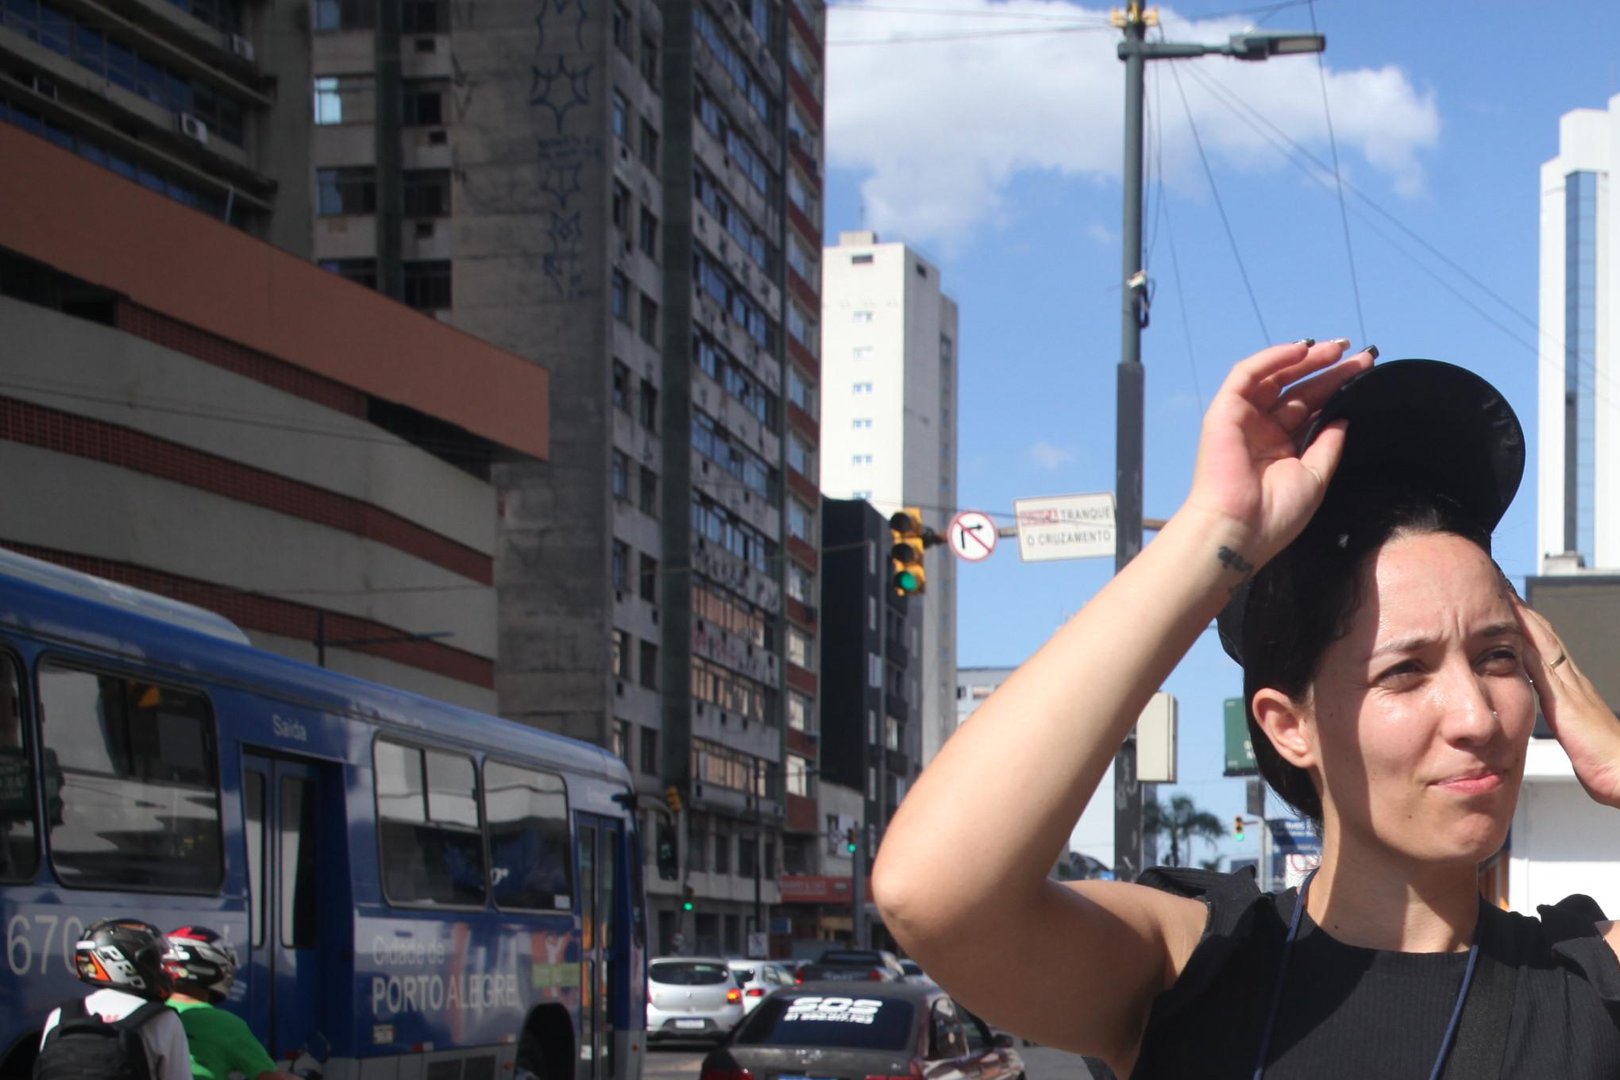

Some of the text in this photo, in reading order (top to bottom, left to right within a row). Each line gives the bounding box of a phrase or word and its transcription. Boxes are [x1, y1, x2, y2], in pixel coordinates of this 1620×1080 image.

[373, 973, 519, 1014] PORTO ALEGRE
[787, 996, 884, 1014] SOS
